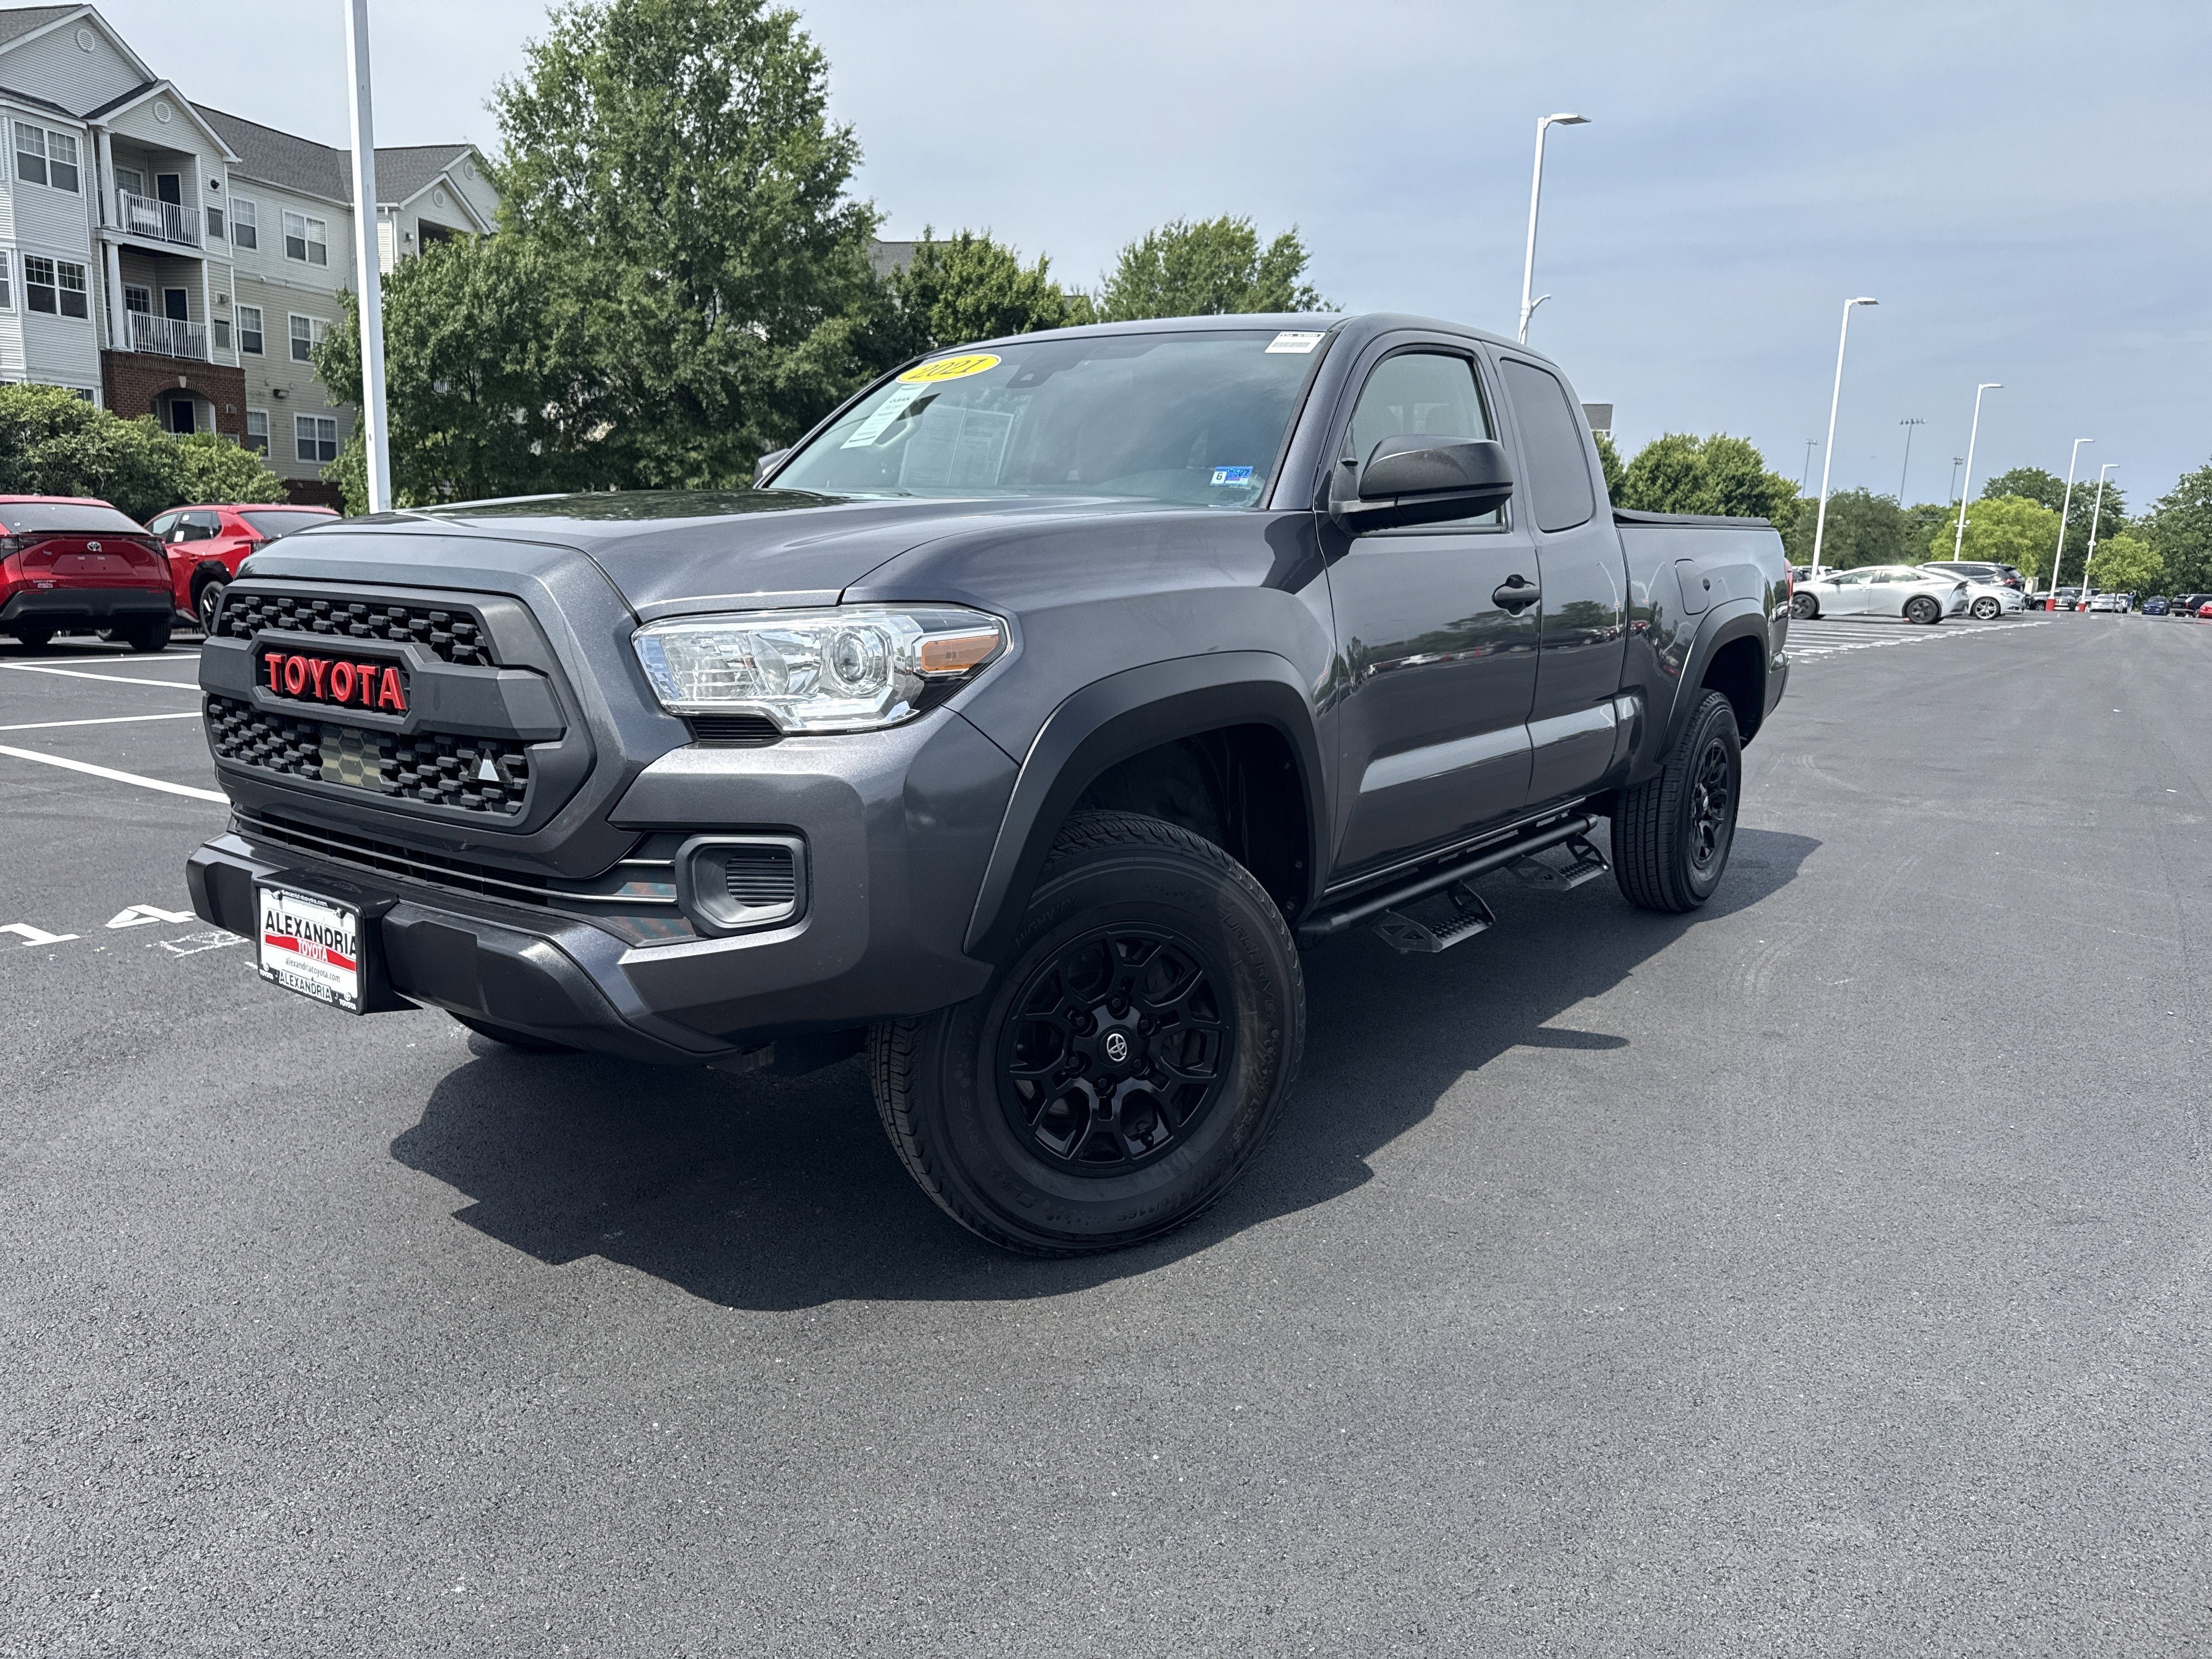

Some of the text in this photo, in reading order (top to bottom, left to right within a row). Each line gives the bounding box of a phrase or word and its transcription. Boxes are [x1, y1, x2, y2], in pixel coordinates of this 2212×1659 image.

[907, 358, 989, 380] 2021
[1216, 472, 1223, 481] 6
[265, 652, 407, 710] TOYOTA
[265, 910, 356, 956] ALEXANDRIA
[1015, 895, 1076, 948] HIGHWAY
[297, 938, 328, 962] TOYOTA
[259, 968, 274, 980] TOYOTA
[285, 957, 341, 983] alexandriatoyota.com
[279, 970, 332, 1003] ALEXANDRIA
[339, 998, 357, 1011] TOYOTA
